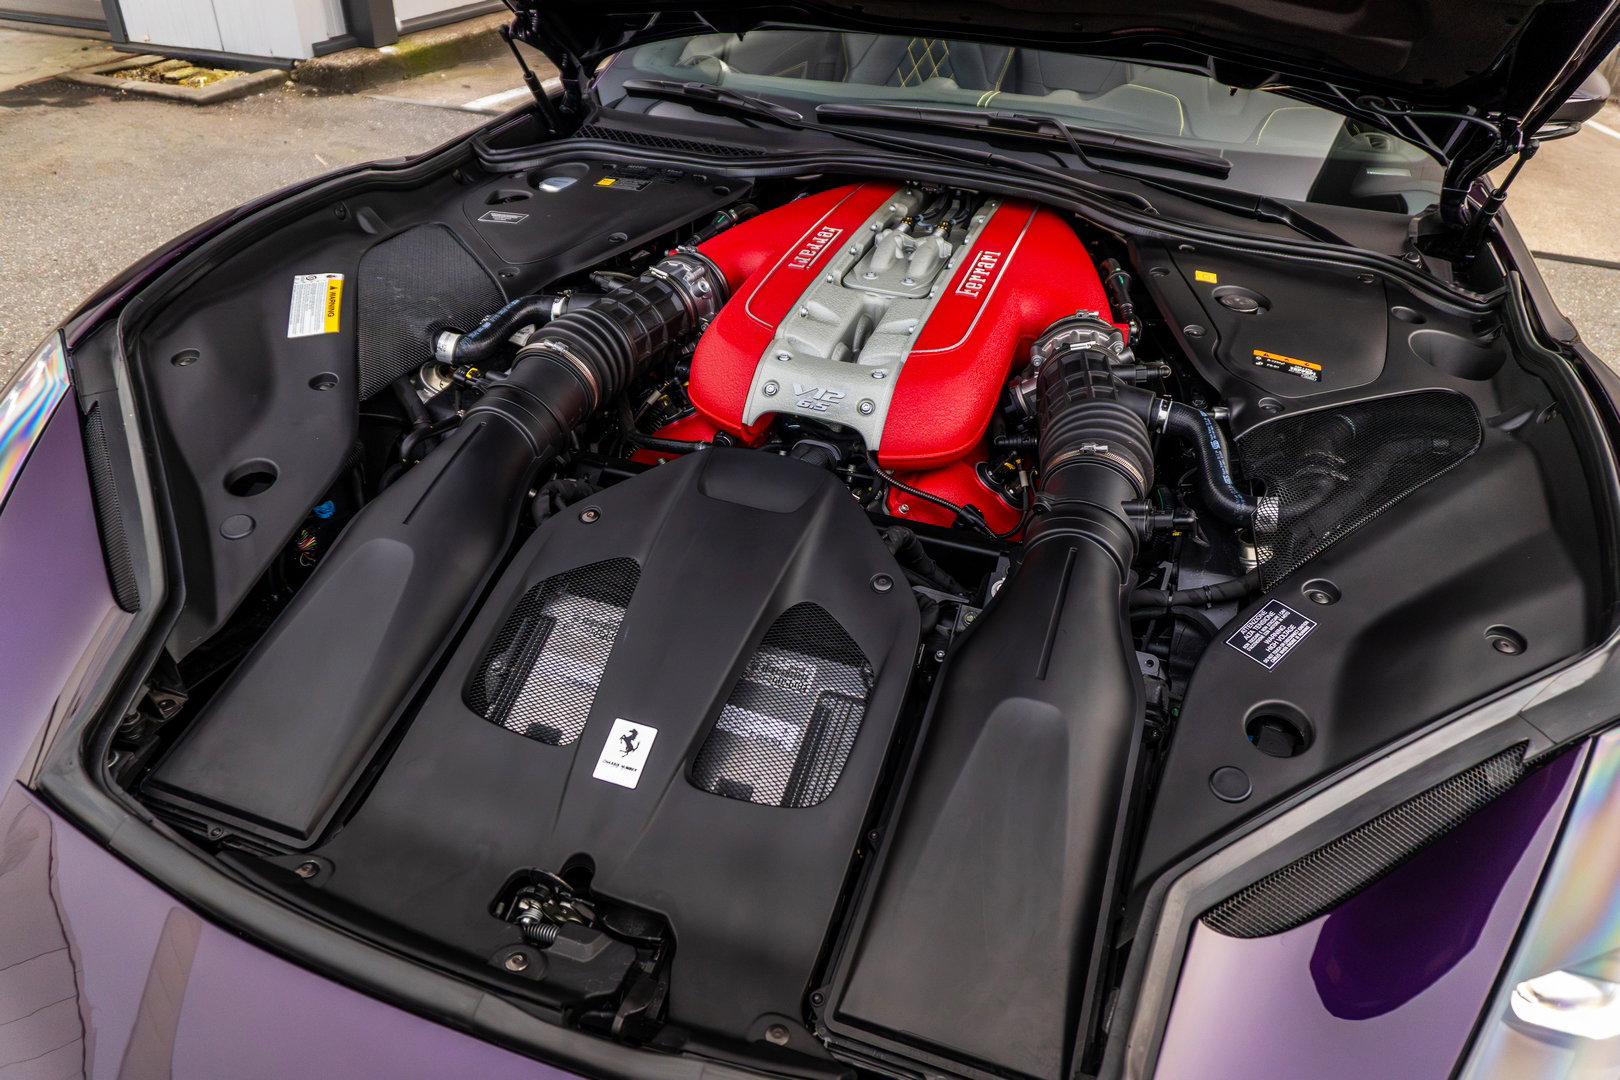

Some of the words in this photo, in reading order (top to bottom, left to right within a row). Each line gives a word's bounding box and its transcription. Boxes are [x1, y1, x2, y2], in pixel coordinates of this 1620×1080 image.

[788, 226, 843, 269] Ferrari
[955, 250, 1001, 298] Ferrari
[327, 291, 337, 318] WARNING
[793, 383, 846, 404] V12
[796, 399, 831, 412] 6.5
[1240, 609, 1268, 635] ATTENZIONE
[1243, 629, 1256, 641] ALTA
[1253, 610, 1276, 631] TENSIONE
[1263, 624, 1287, 645] WARNING
[1265, 640, 1279, 652] HIGH
[1276, 623, 1297, 642] VOLTAGE
